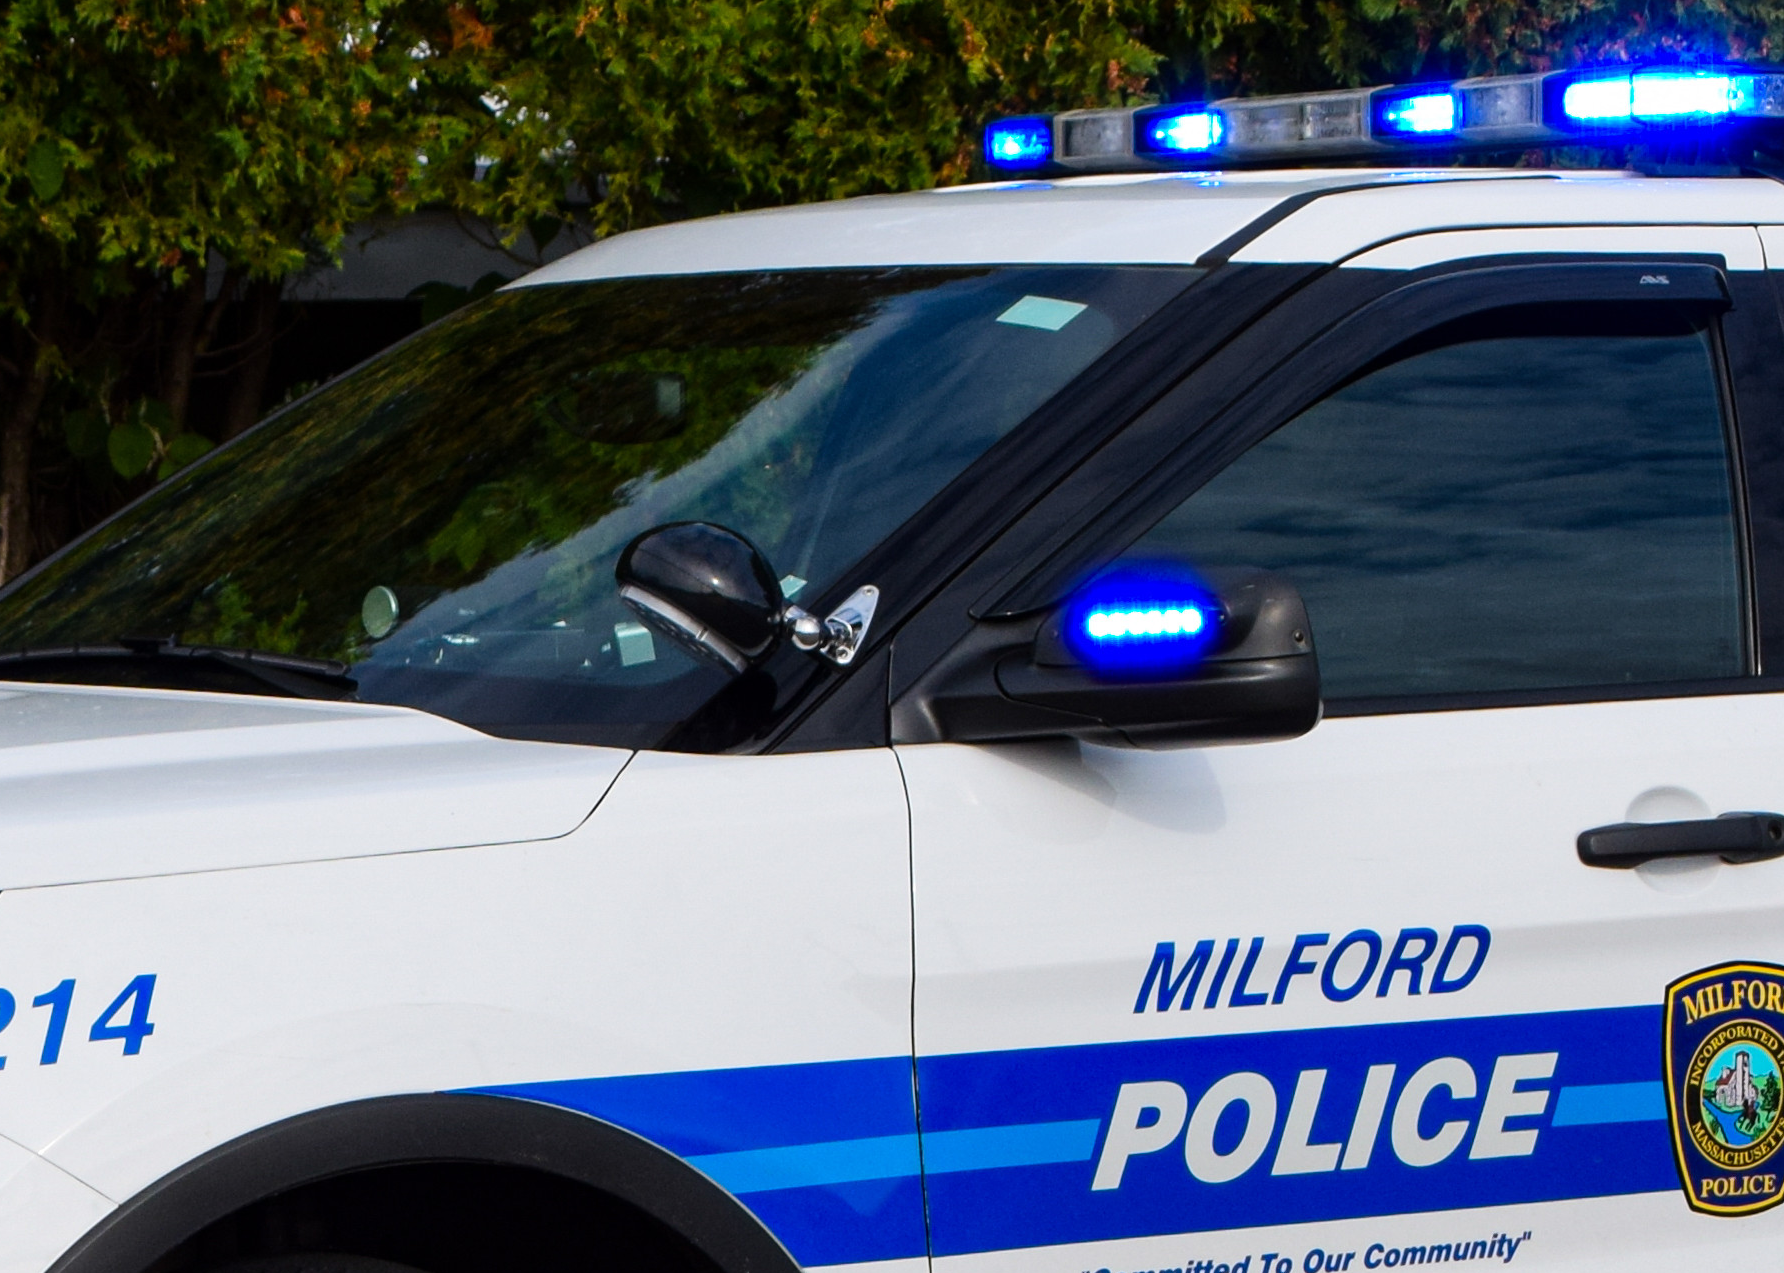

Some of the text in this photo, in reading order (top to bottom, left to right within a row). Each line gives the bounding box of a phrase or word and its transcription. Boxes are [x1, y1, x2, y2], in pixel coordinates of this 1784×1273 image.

[1133, 923, 1492, 1015] MILFORD
[1689, 1025, 1777, 1086] INCORPORATED
[1090, 1051, 1559, 1192] POLICE
[1700, 1173, 1777, 1198] POLICE
[1363, 1230, 1533, 1271] Community"
